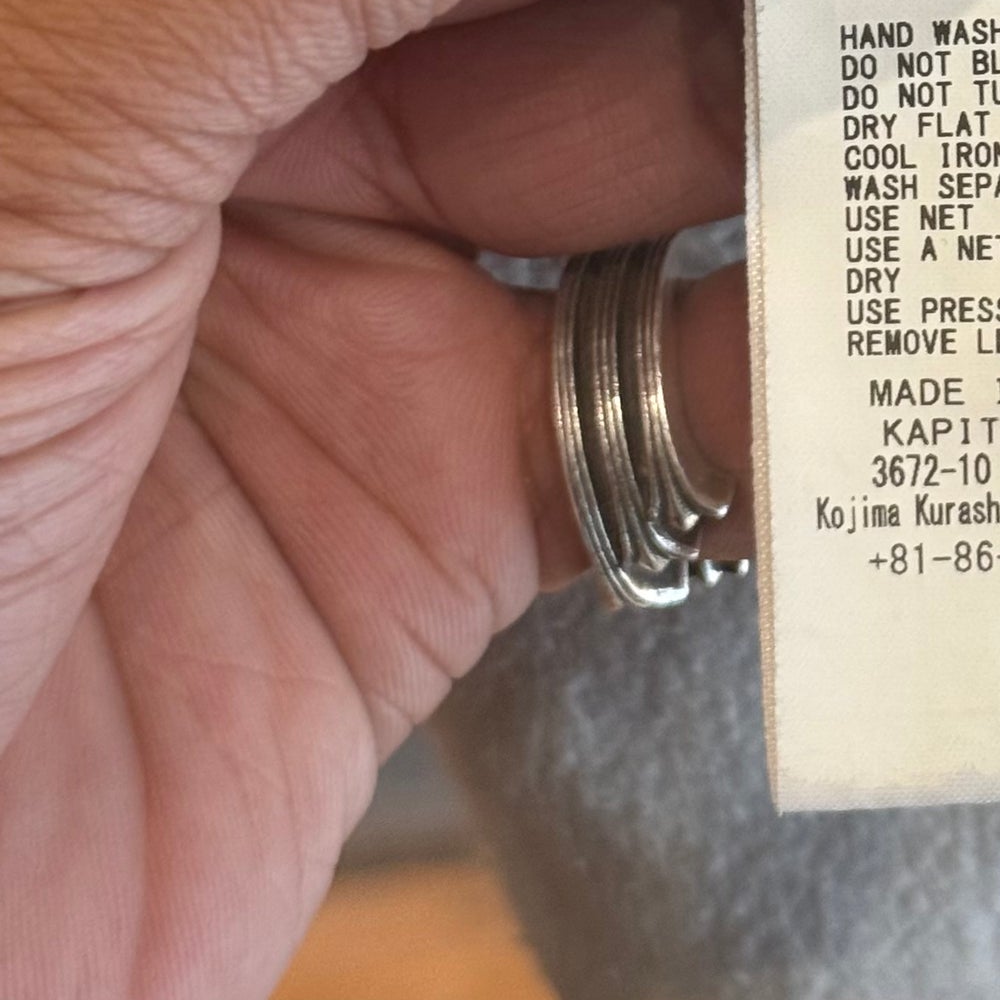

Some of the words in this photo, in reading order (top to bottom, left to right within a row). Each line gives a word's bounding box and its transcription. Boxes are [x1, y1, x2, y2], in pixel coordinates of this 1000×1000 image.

[840, 22, 914, 50] HAND
[840, 55, 878, 81] DO
[897, 52, 953, 78] NOT
[842, 85, 878, 111] DO
[898, 82, 953, 108] NOT
[843, 115, 898, 140] DRY
[917, 111, 991, 138] FLAT
[844, 144, 917, 171] COOL
[844, 175, 918, 201] WASH
[845, 206, 900, 232] USE
[919, 205, 974, 230] NET
[845, 237, 901, 262] USE
[920, 237, 939, 261] A
[845, 268, 901, 294] DRY
[846, 299, 901, 324] USE
[846, 329, 958, 356] REMOVE
[868, 378, 965, 406] MADE
[870, 453, 992, 487] 3672-10
[815, 497, 901, 533] Kojima
